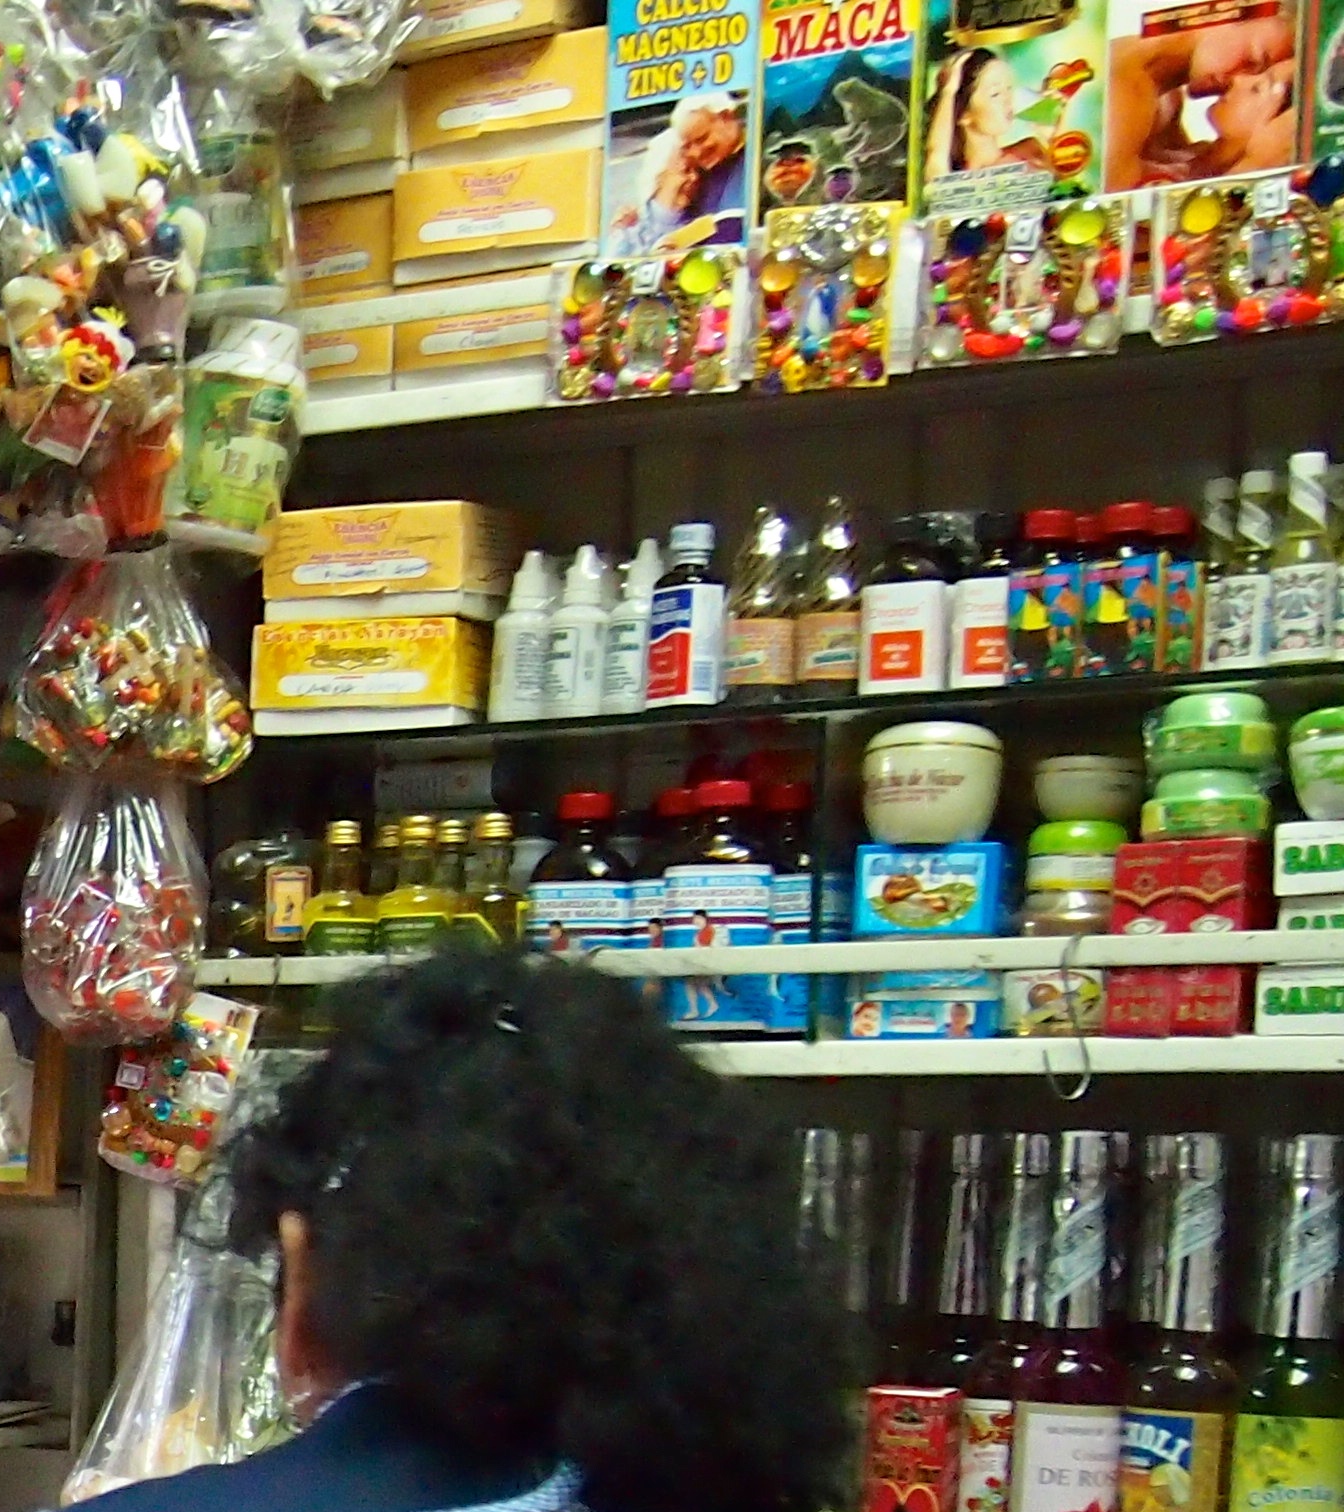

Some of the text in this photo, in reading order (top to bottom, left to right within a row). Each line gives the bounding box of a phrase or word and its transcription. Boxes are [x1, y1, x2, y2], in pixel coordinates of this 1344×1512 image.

[616, 13, 748, 66] MAGNESIO
[768, 0, 909, 63] MACA
[626, 60, 685, 100] ZINC
[713, 51, 733, 84] D
[1039, 1466, 1072, 1488] DE
